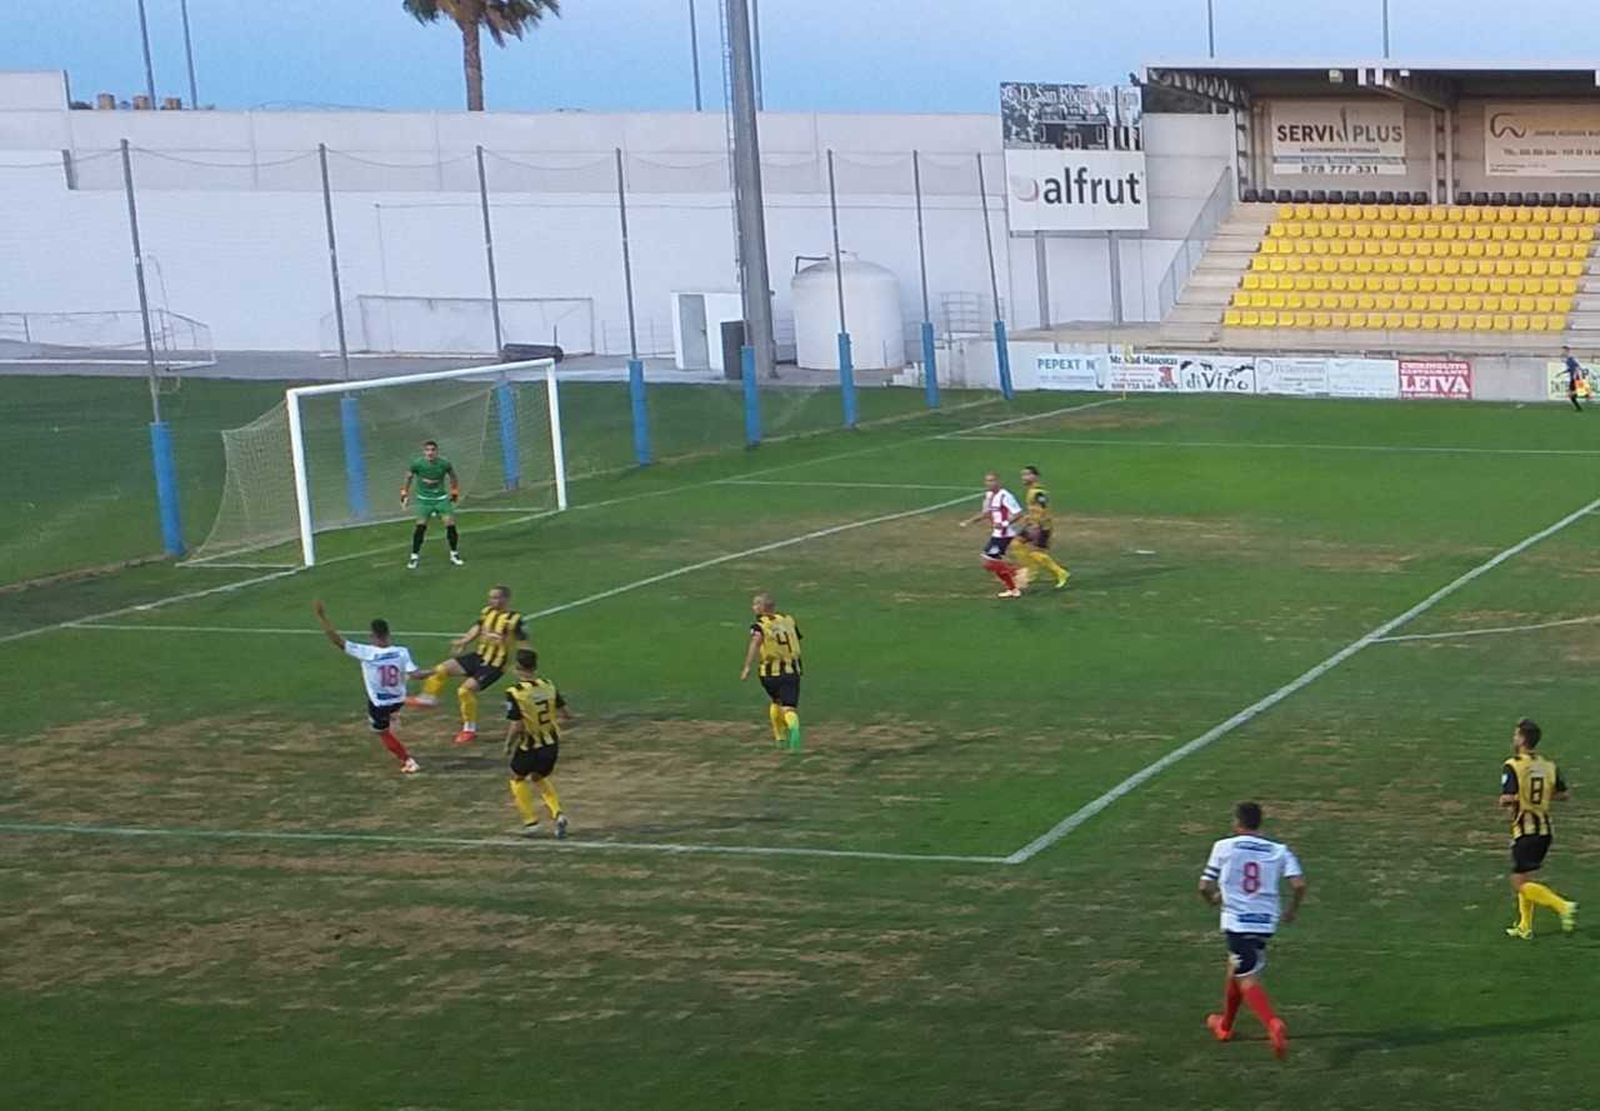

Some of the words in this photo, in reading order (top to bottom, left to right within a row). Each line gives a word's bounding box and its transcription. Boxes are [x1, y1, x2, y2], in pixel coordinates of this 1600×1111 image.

[1352, 125, 1402, 142] PLUS
[1043, 167, 1141, 204] alfrut
[1400, 375, 1471, 393] LEIVA
[775, 631, 793, 654] 4
[379, 664, 399, 688] 18
[535, 699, 551, 726] 2
[1530, 777, 1544, 805] 8
[1242, 861, 1261, 894] 8
